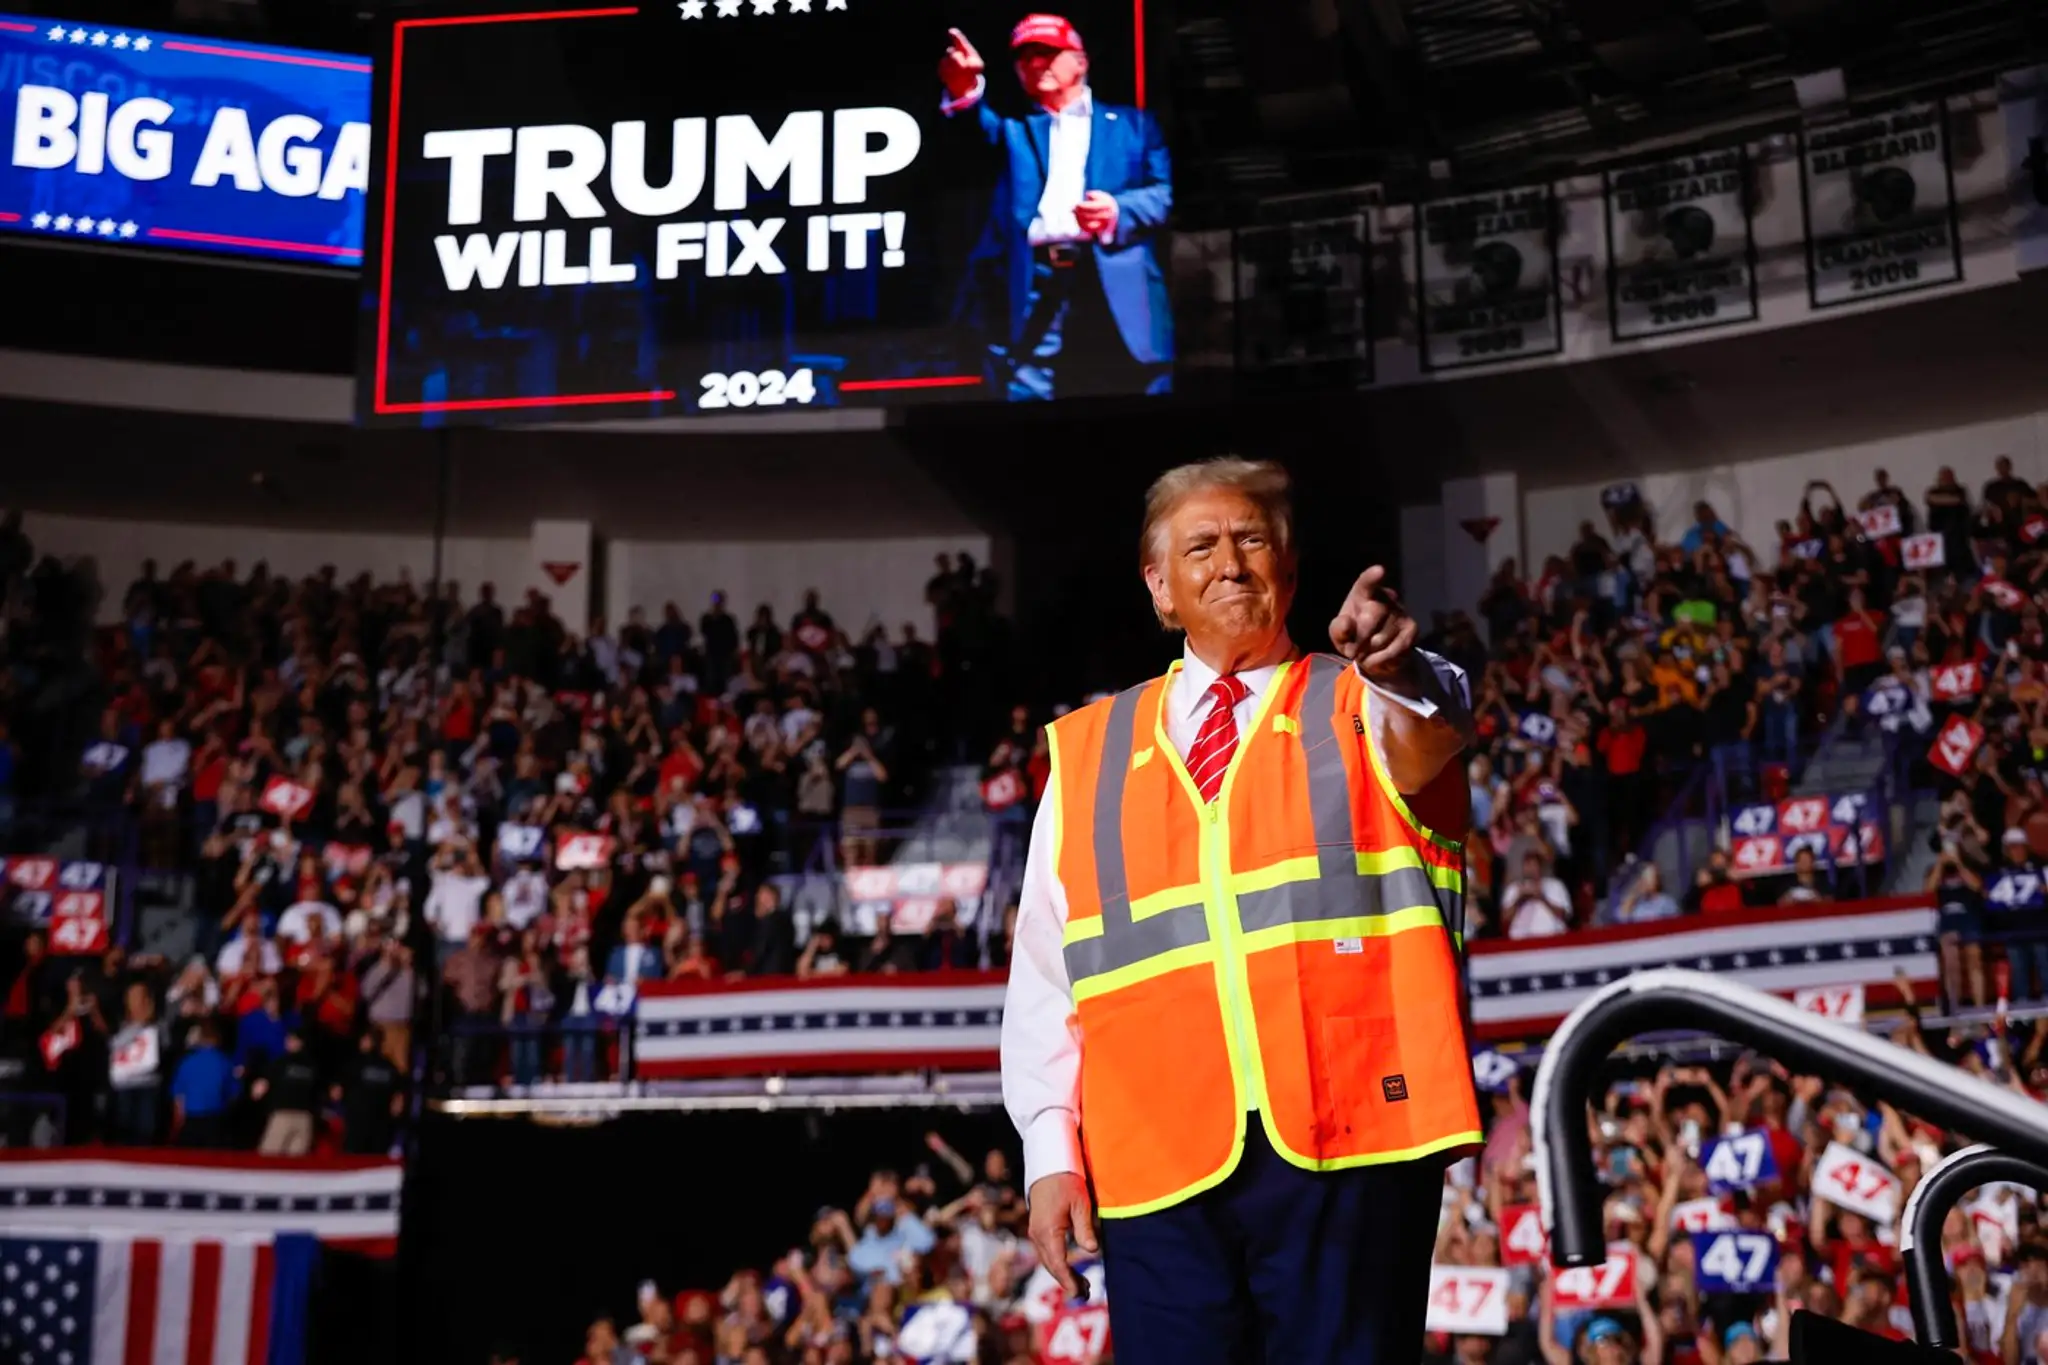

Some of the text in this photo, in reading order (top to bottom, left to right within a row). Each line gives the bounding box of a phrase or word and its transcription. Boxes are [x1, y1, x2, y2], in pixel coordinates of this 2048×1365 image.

[12, 84, 372, 200] BIG AGA
[423, 106, 922, 225] TRUMP
[434, 211, 906, 291] WILL FIX IT!
[698, 368, 817, 409] 2024
[1936, 661, 1975, 696] 47
[1733, 805, 1776, 836] 47
[1781, 799, 1825, 831] 47
[1735, 837, 1777, 867] 47
[10, 860, 56, 888] 47
[61, 861, 103, 889] 47
[1988, 873, 2040, 907] 47
[52, 918, 102, 951] 47
[1803, 986, 1853, 1018] 47
[1705, 1132, 1766, 1186] 47
[1829, 1163, 1892, 1200] 47
[1701, 1233, 1773, 1285] 47
[1555, 1255, 1630, 1301] 47
[1430, 1276, 1496, 1319] 47
[1047, 1309, 1108, 1361] 47
